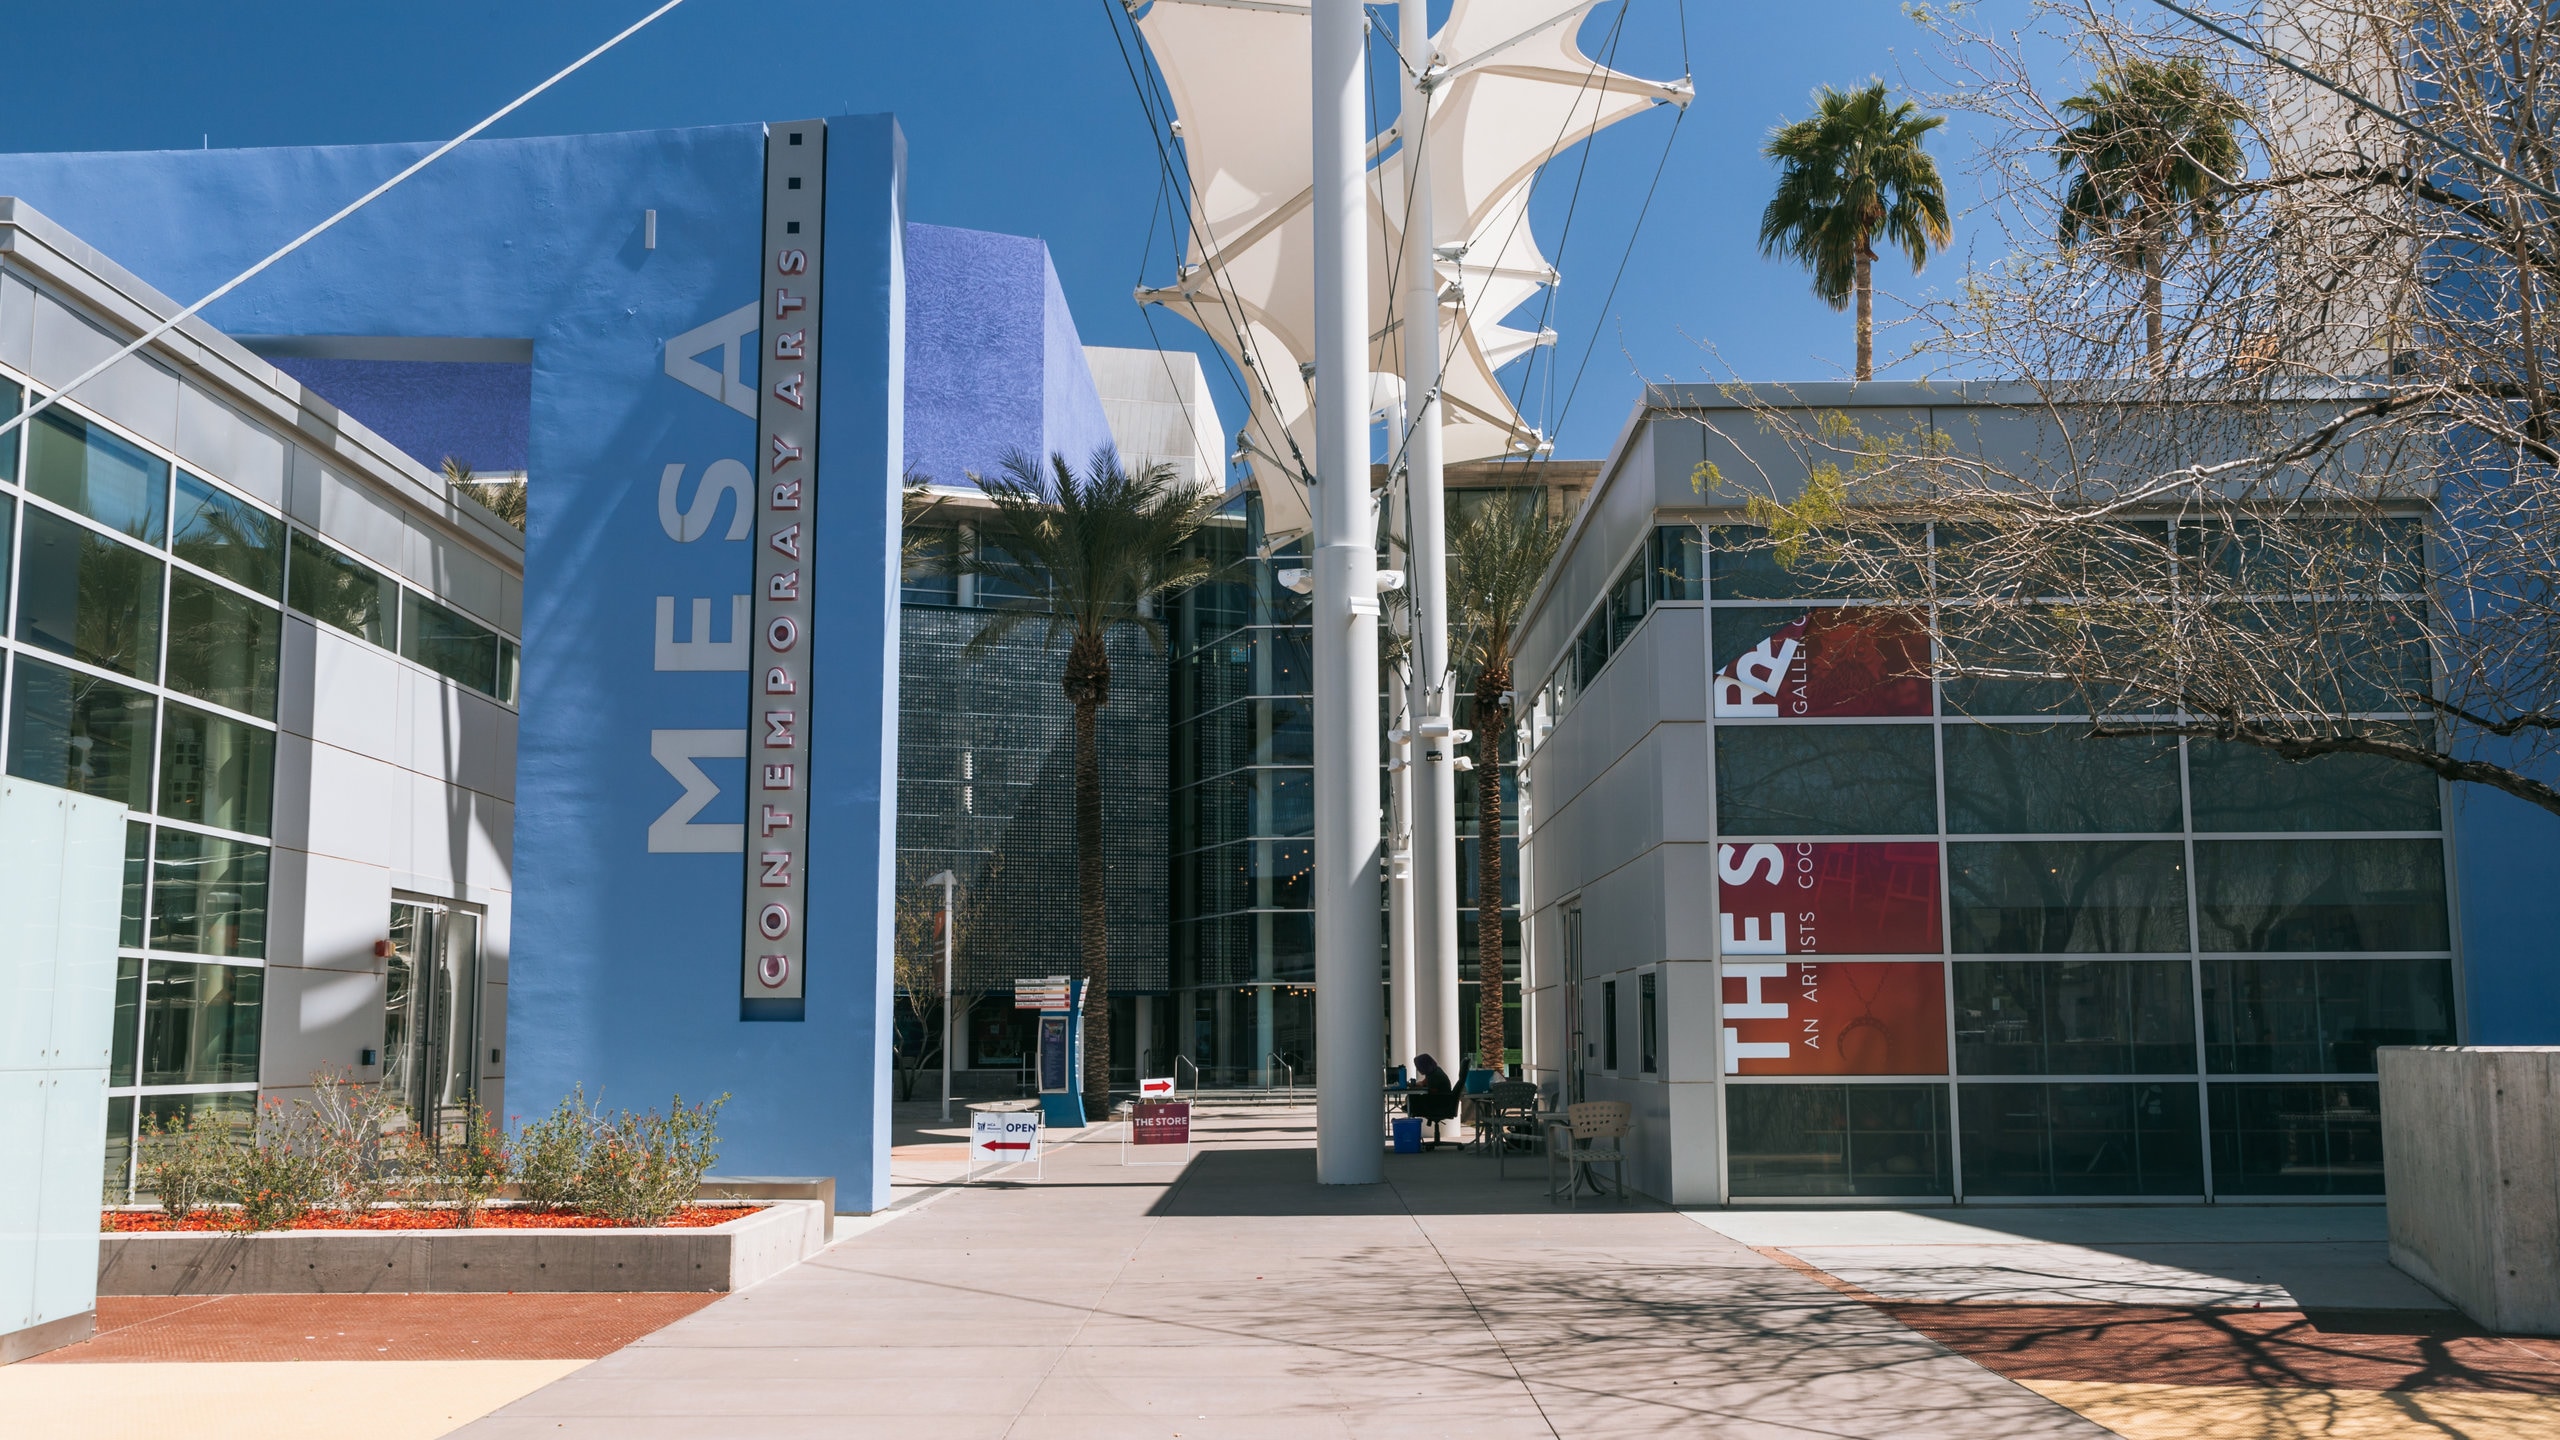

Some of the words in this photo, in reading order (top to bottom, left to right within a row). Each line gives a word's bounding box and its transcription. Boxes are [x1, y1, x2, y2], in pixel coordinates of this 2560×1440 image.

[774, 248, 807, 411] ARTS
[647, 300, 760, 853] MESA
[757, 434, 802, 988] CONTEMPORARY
[1718, 843, 1785, 886] S
[1720, 912, 1790, 1073] THE
[1799, 911, 1818, 1003] ARTISTS
[1803, 1018, 1820, 1050] AN
[1006, 1123, 1036, 1133] OPEN
[1135, 1117, 1154, 1127] THE
[1155, 1116, 1188, 1126] STORE
